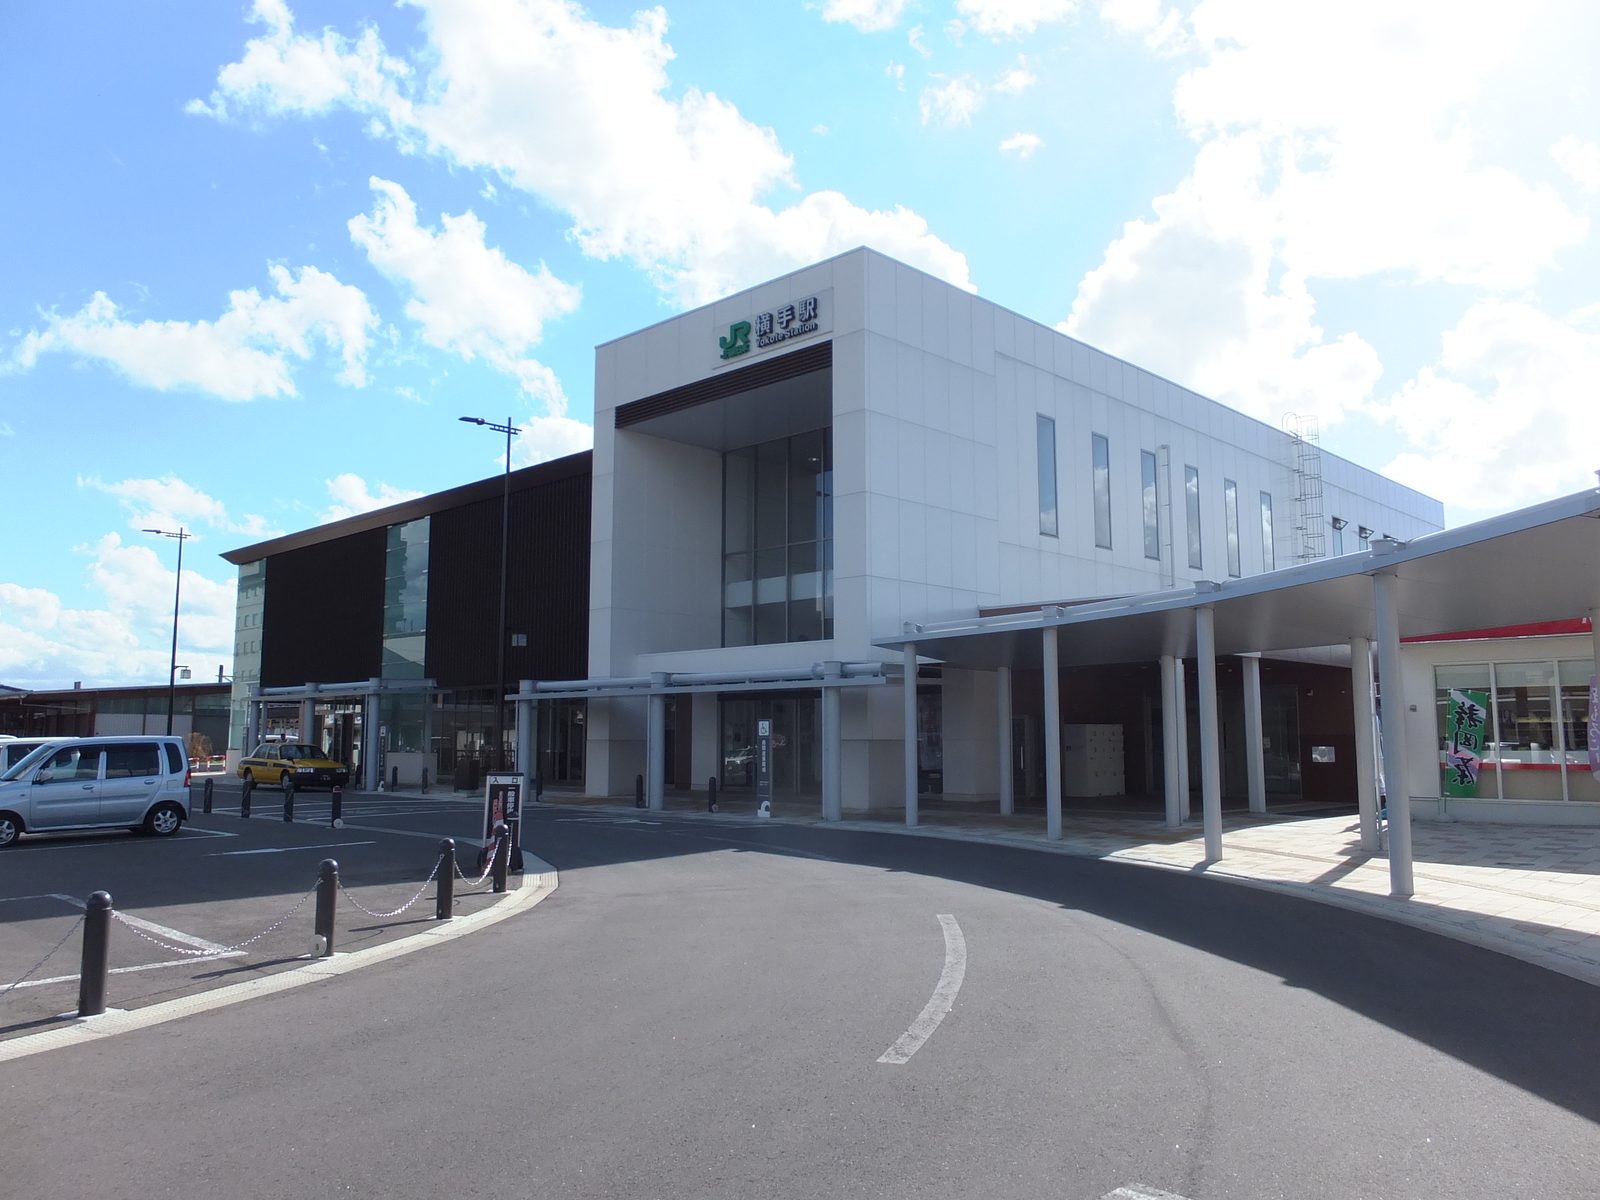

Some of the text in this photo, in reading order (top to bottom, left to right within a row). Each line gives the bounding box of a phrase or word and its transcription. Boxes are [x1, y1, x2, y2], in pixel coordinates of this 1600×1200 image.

[755, 298, 817, 337] 横手駅
[719, 320, 751, 348] JR
[757, 322, 817, 347] Yokote Station
